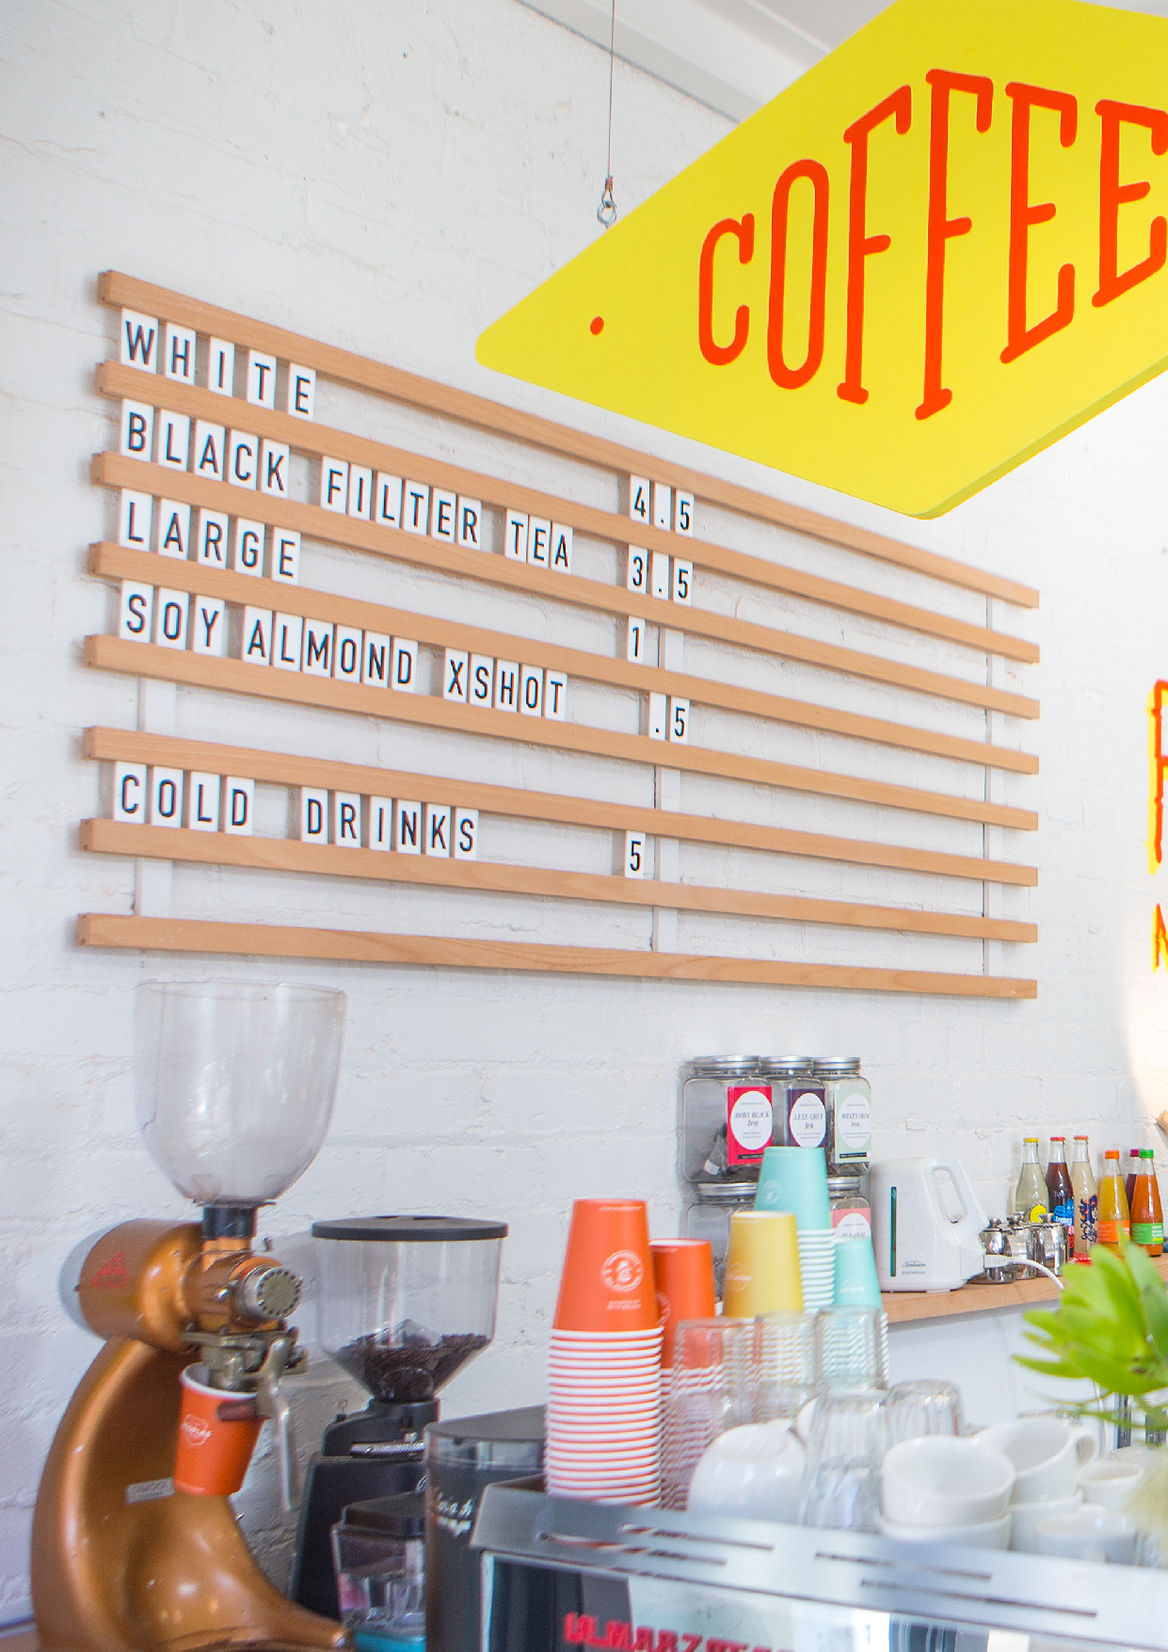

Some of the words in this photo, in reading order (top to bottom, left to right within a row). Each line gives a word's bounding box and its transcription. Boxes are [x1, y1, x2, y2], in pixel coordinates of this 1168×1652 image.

[124, 319, 311, 415] WHITE
[633, 484, 692, 532] 4.5
[126, 501, 297, 578] LARGE
[632, 625, 641, 659] 1
[128, 413, 287, 493] BLACK
[327, 468, 479, 544] FILTER
[510, 519, 569, 568] TEA
[632, 555, 691, 599] 3.5
[125, 594, 219, 648] SOY
[246, 617, 413, 687] ALMOND
[447, 659, 565, 715] XSHOT
[121, 774, 249, 827] COLD
[307, 798, 475, 853] DRINKS
[629, 838, 643, 873] 5
